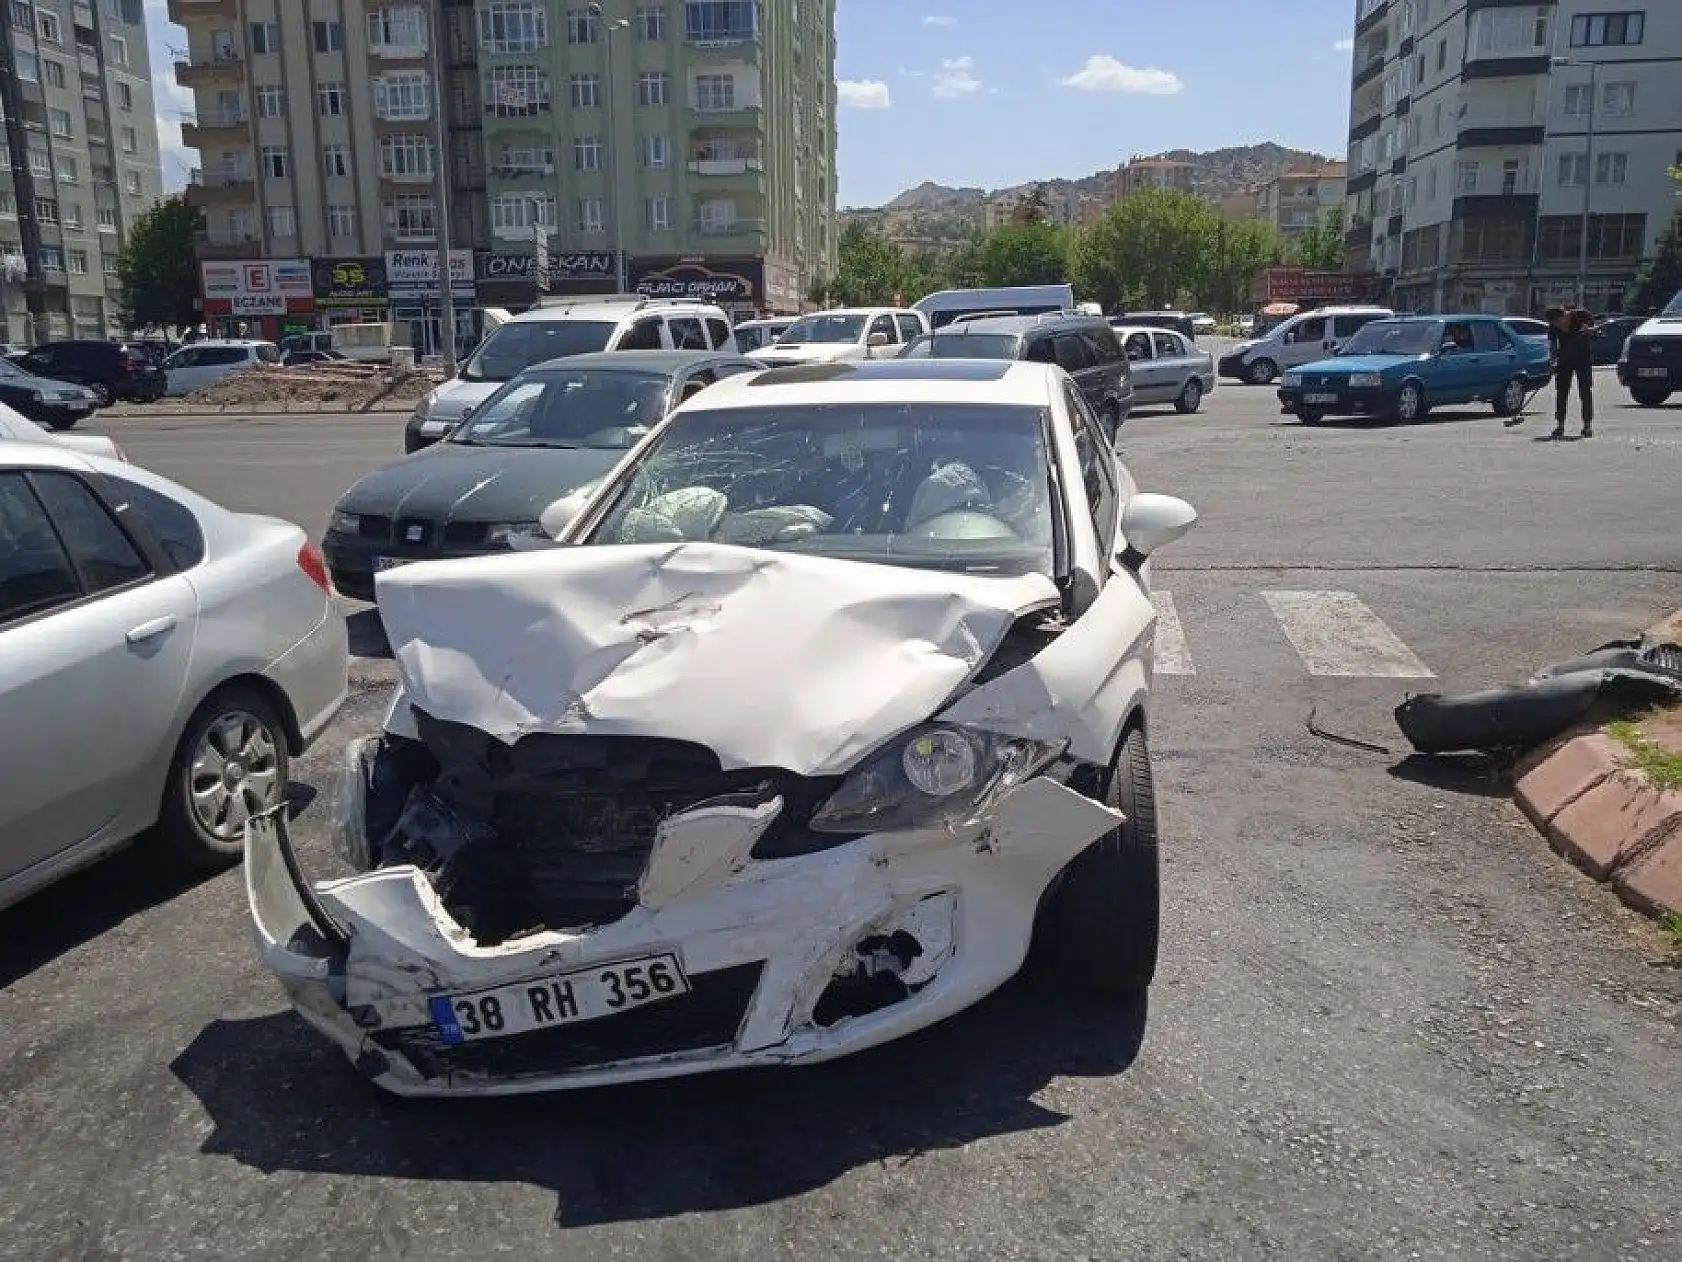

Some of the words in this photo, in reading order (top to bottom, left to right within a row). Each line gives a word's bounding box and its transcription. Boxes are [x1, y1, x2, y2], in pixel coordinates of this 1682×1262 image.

[392, 253, 428, 266] Renk
[234, 295, 282, 308] ECZANE
[455, 997, 504, 1034] 38
[528, 980, 579, 1022] RH
[601, 962, 676, 1008] 356
